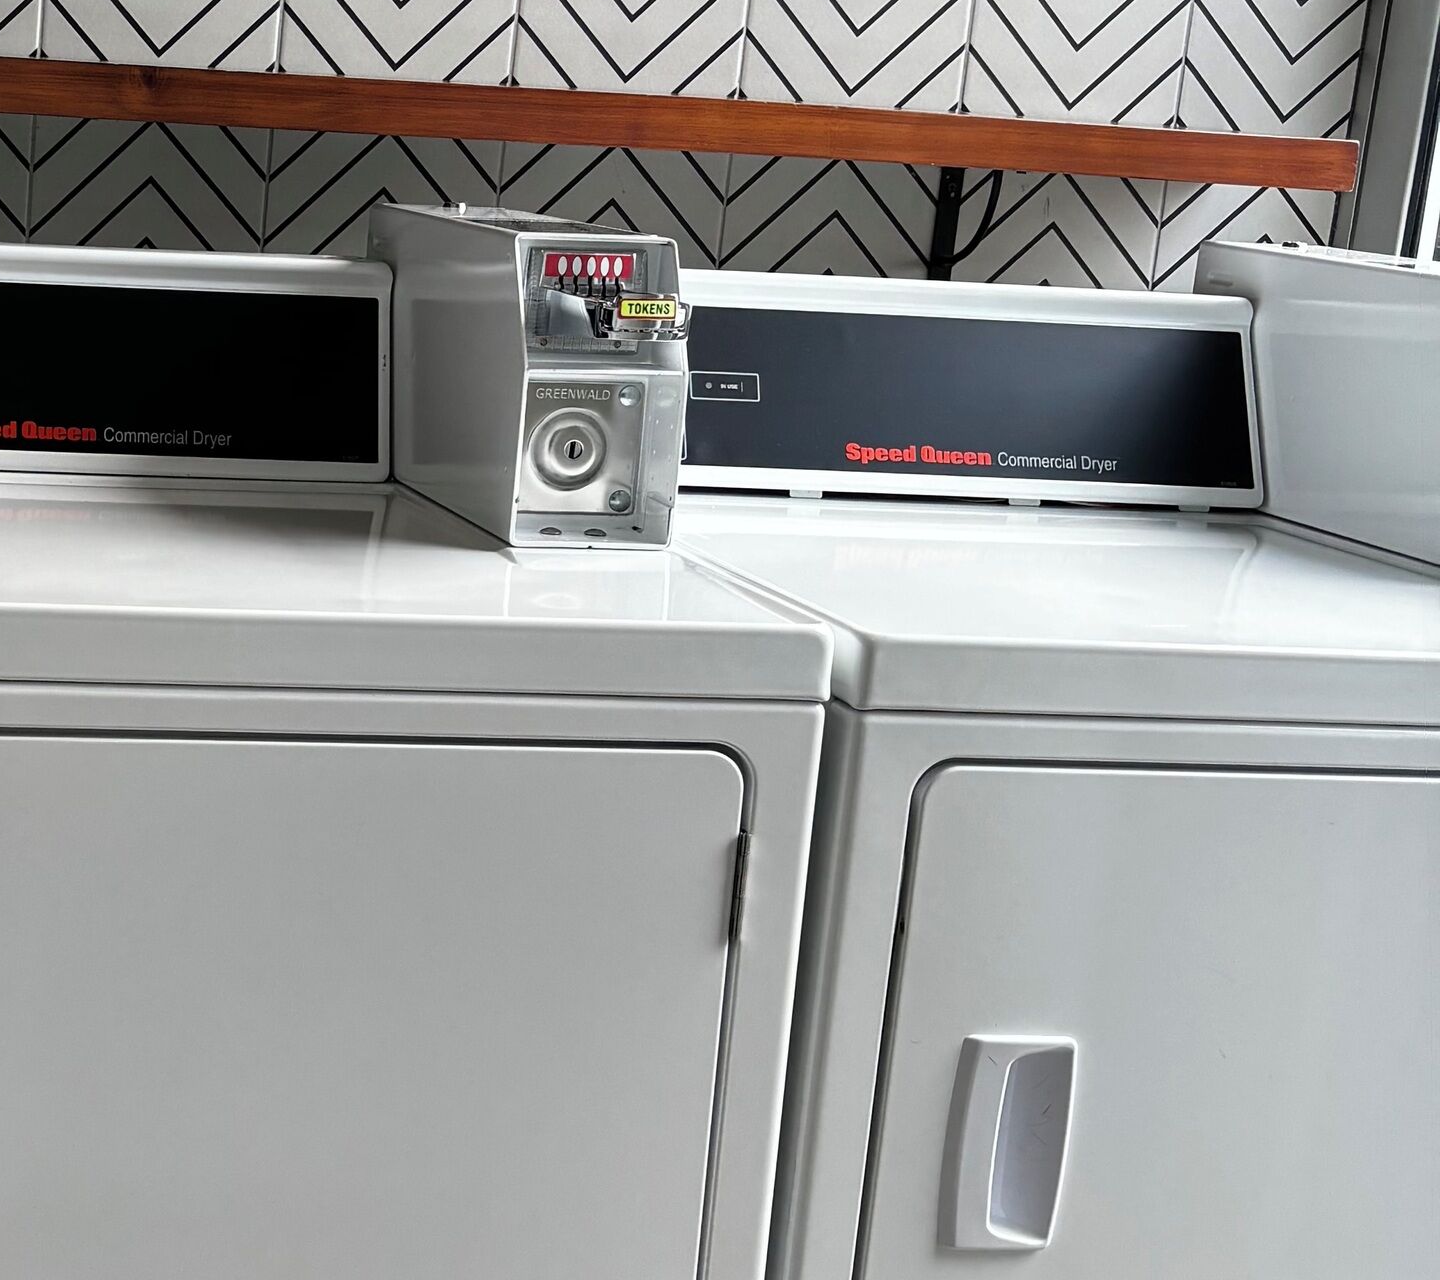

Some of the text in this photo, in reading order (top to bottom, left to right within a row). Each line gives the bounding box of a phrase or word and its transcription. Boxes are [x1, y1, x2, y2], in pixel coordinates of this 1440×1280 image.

[627, 303, 670, 315] TOKENS
[535, 387, 611, 401] GREENWALD
[21, 420, 97, 442] Queen
[103, 426, 188, 445] Commercial
[193, 430, 232, 449] Dryer
[845, 442, 1117, 474] Speed Queen Commercial Dryer
